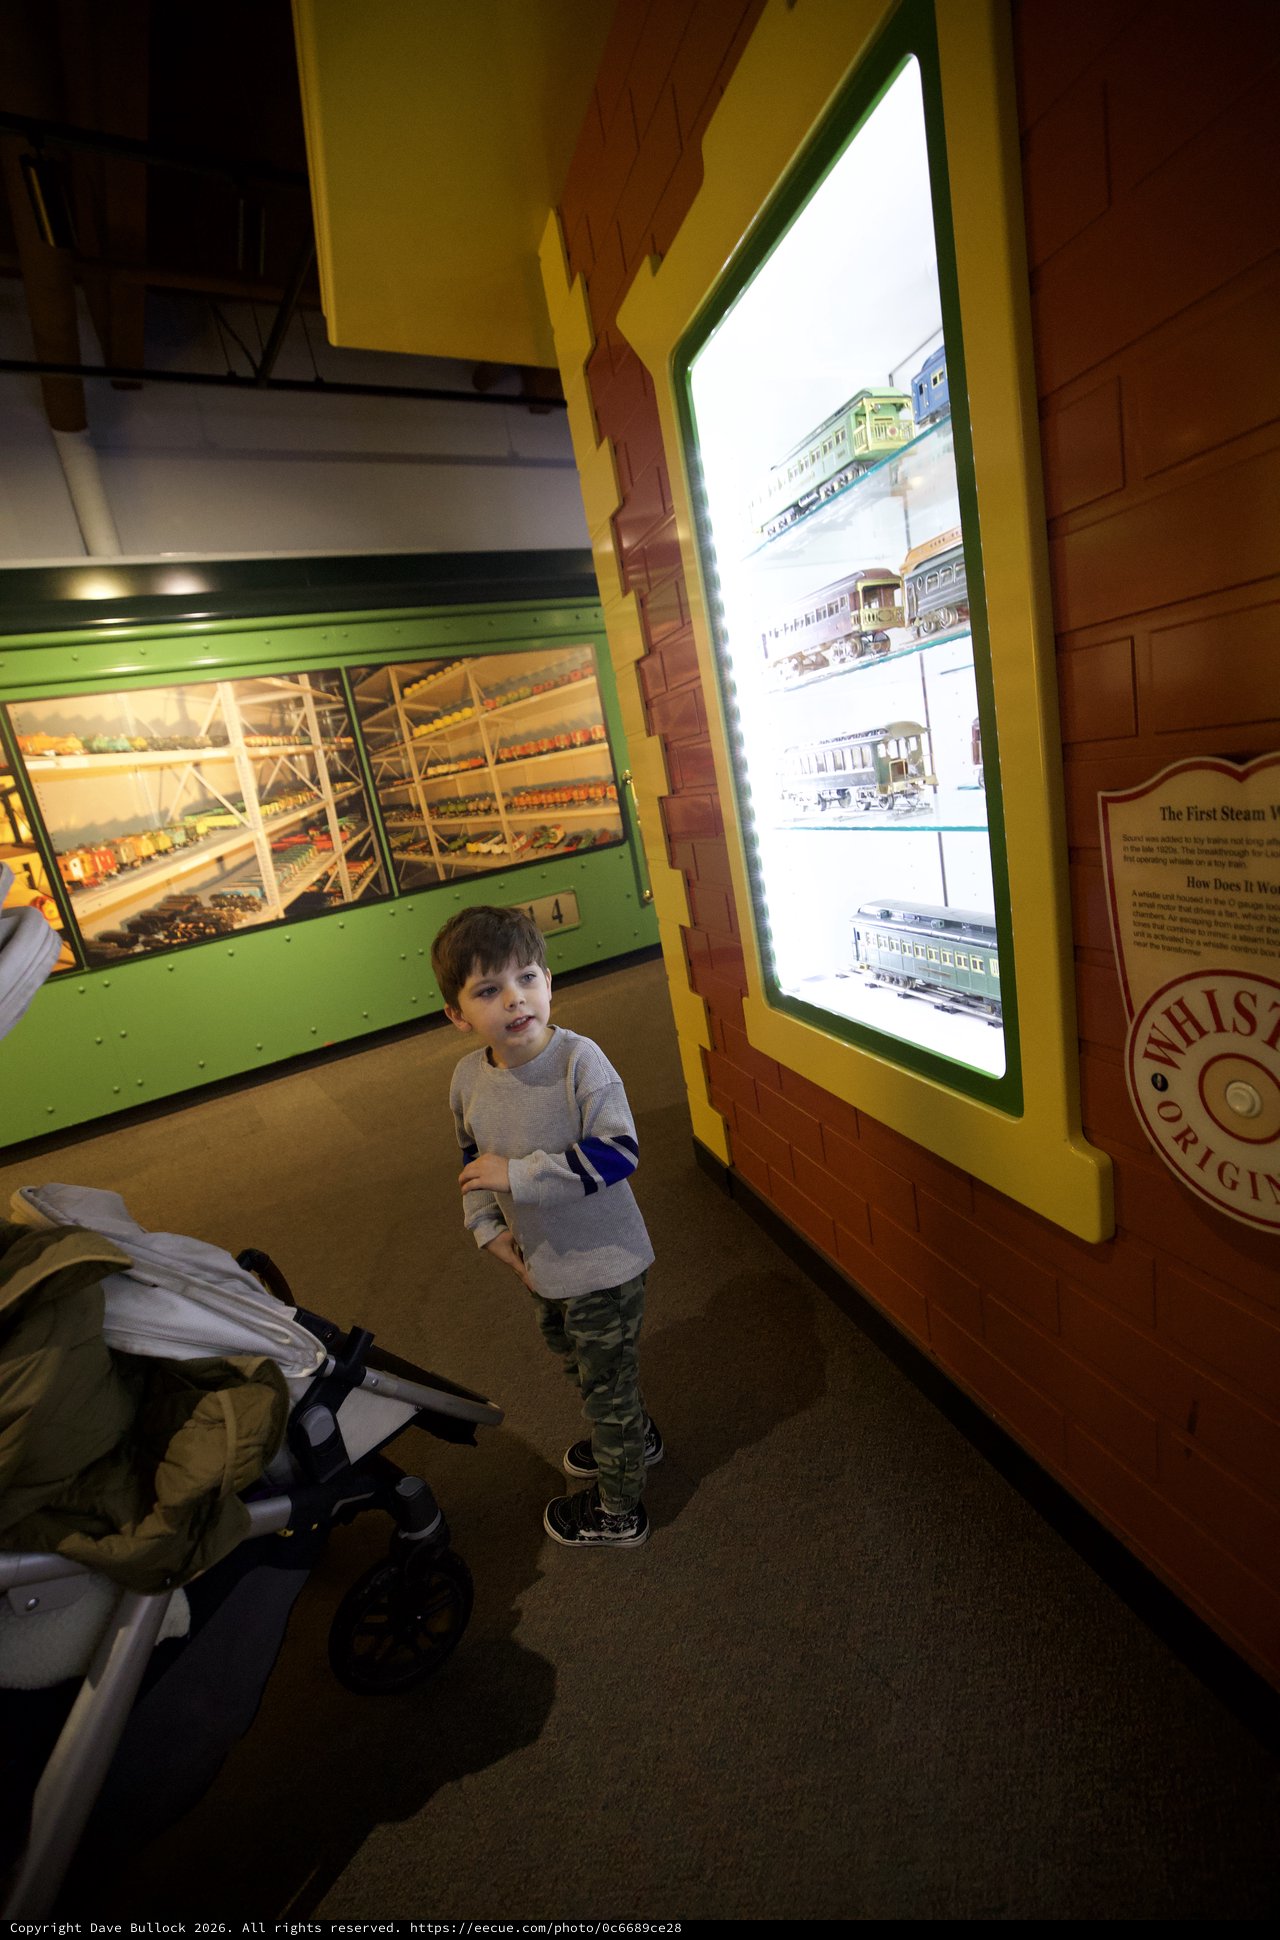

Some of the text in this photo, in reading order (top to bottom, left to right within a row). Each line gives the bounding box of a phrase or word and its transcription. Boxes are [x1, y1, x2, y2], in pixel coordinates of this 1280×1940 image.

[1160, 805, 1183, 821] The
[1186, 805, 1217, 821] First
[1221, 806, 1265, 821] Steam
[1122, 834, 1143, 842] Sound
[1161, 835, 1183, 843] added
[1193, 836, 1205, 845] toy
[1187, 876, 1210, 888] How
[1214, 878, 1241, 891] Does
[1245, 880, 1253, 892] It
